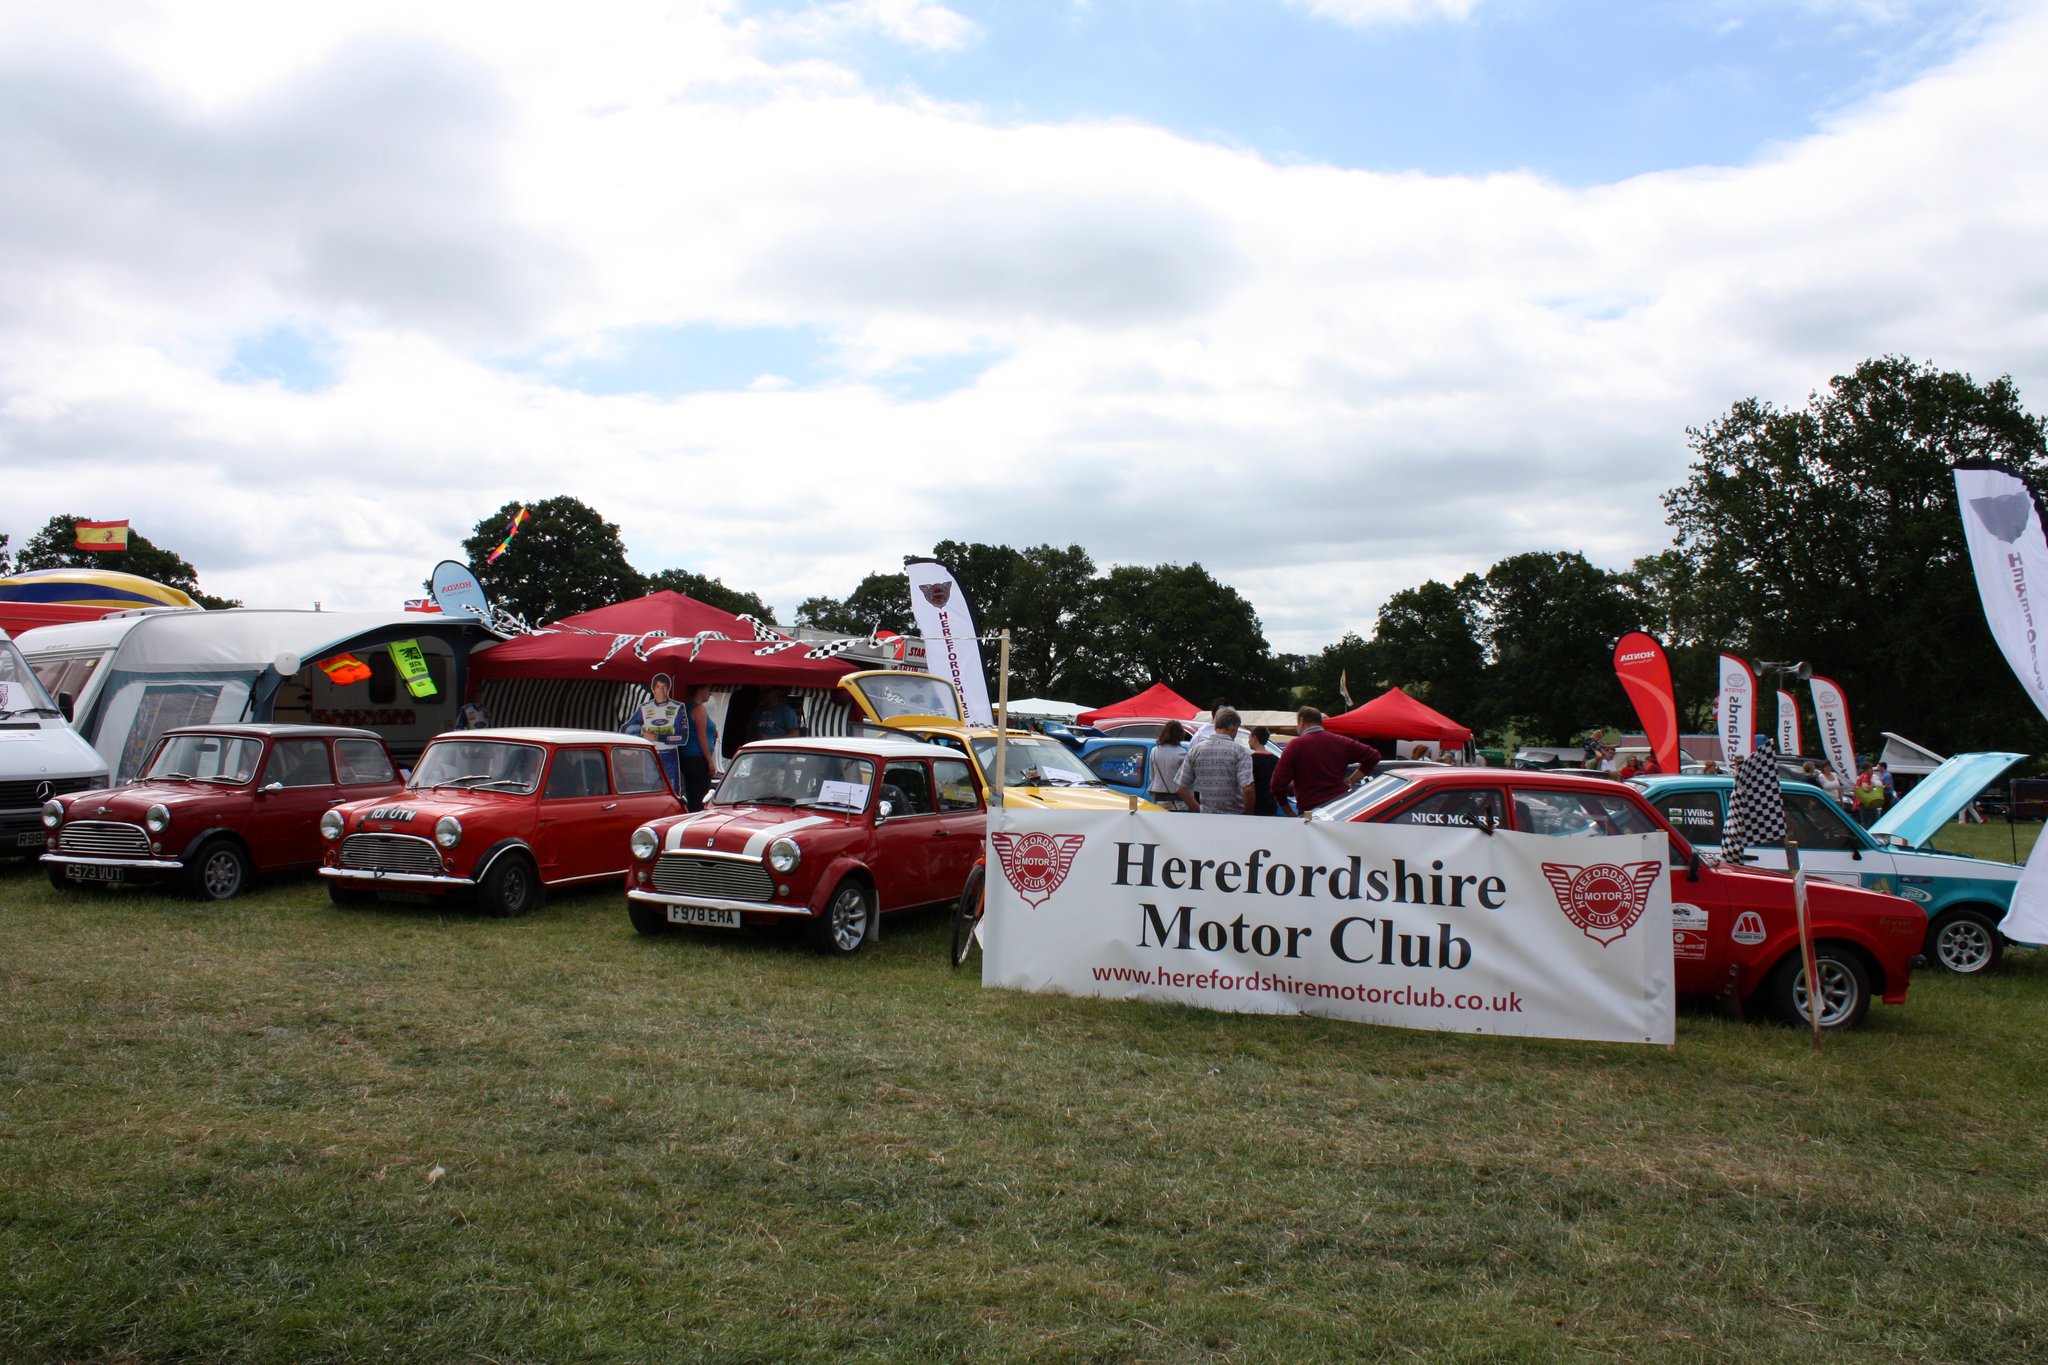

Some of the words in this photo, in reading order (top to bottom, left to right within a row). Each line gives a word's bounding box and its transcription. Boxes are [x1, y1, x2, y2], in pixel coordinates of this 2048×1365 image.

[908, 646, 926, 658] STAR
[939, 612, 970, 719] HEREFORDSHIRE
[389, 808, 416, 821] UTW
[1411, 812, 1444, 824] NICK
[1687, 809, 1713, 817] Wilks
[1687, 817, 1714, 825] Wilks
[1015, 836, 1057, 874] HEREFORDSHIRE
[1022, 857, 1050, 867] MOTOR
[66, 864, 97, 878] C573
[99, 868, 122, 880] VUT
[1111, 842, 1506, 910] Herefordshire
[1024, 878, 1046, 888] CLUB
[1574, 868, 1632, 909] HEREFORDSHIRE
[1584, 892, 1623, 901] MOTOR
[673, 905, 705, 922] F978
[708, 909, 734, 924] EHA
[1587, 913, 1619, 924] CLUB
[1136, 903, 1313, 959] Motor
[1330, 916, 1472, 970] Club
[1092, 966, 1523, 1012] www.herefordshiremotorclub.co.uk
